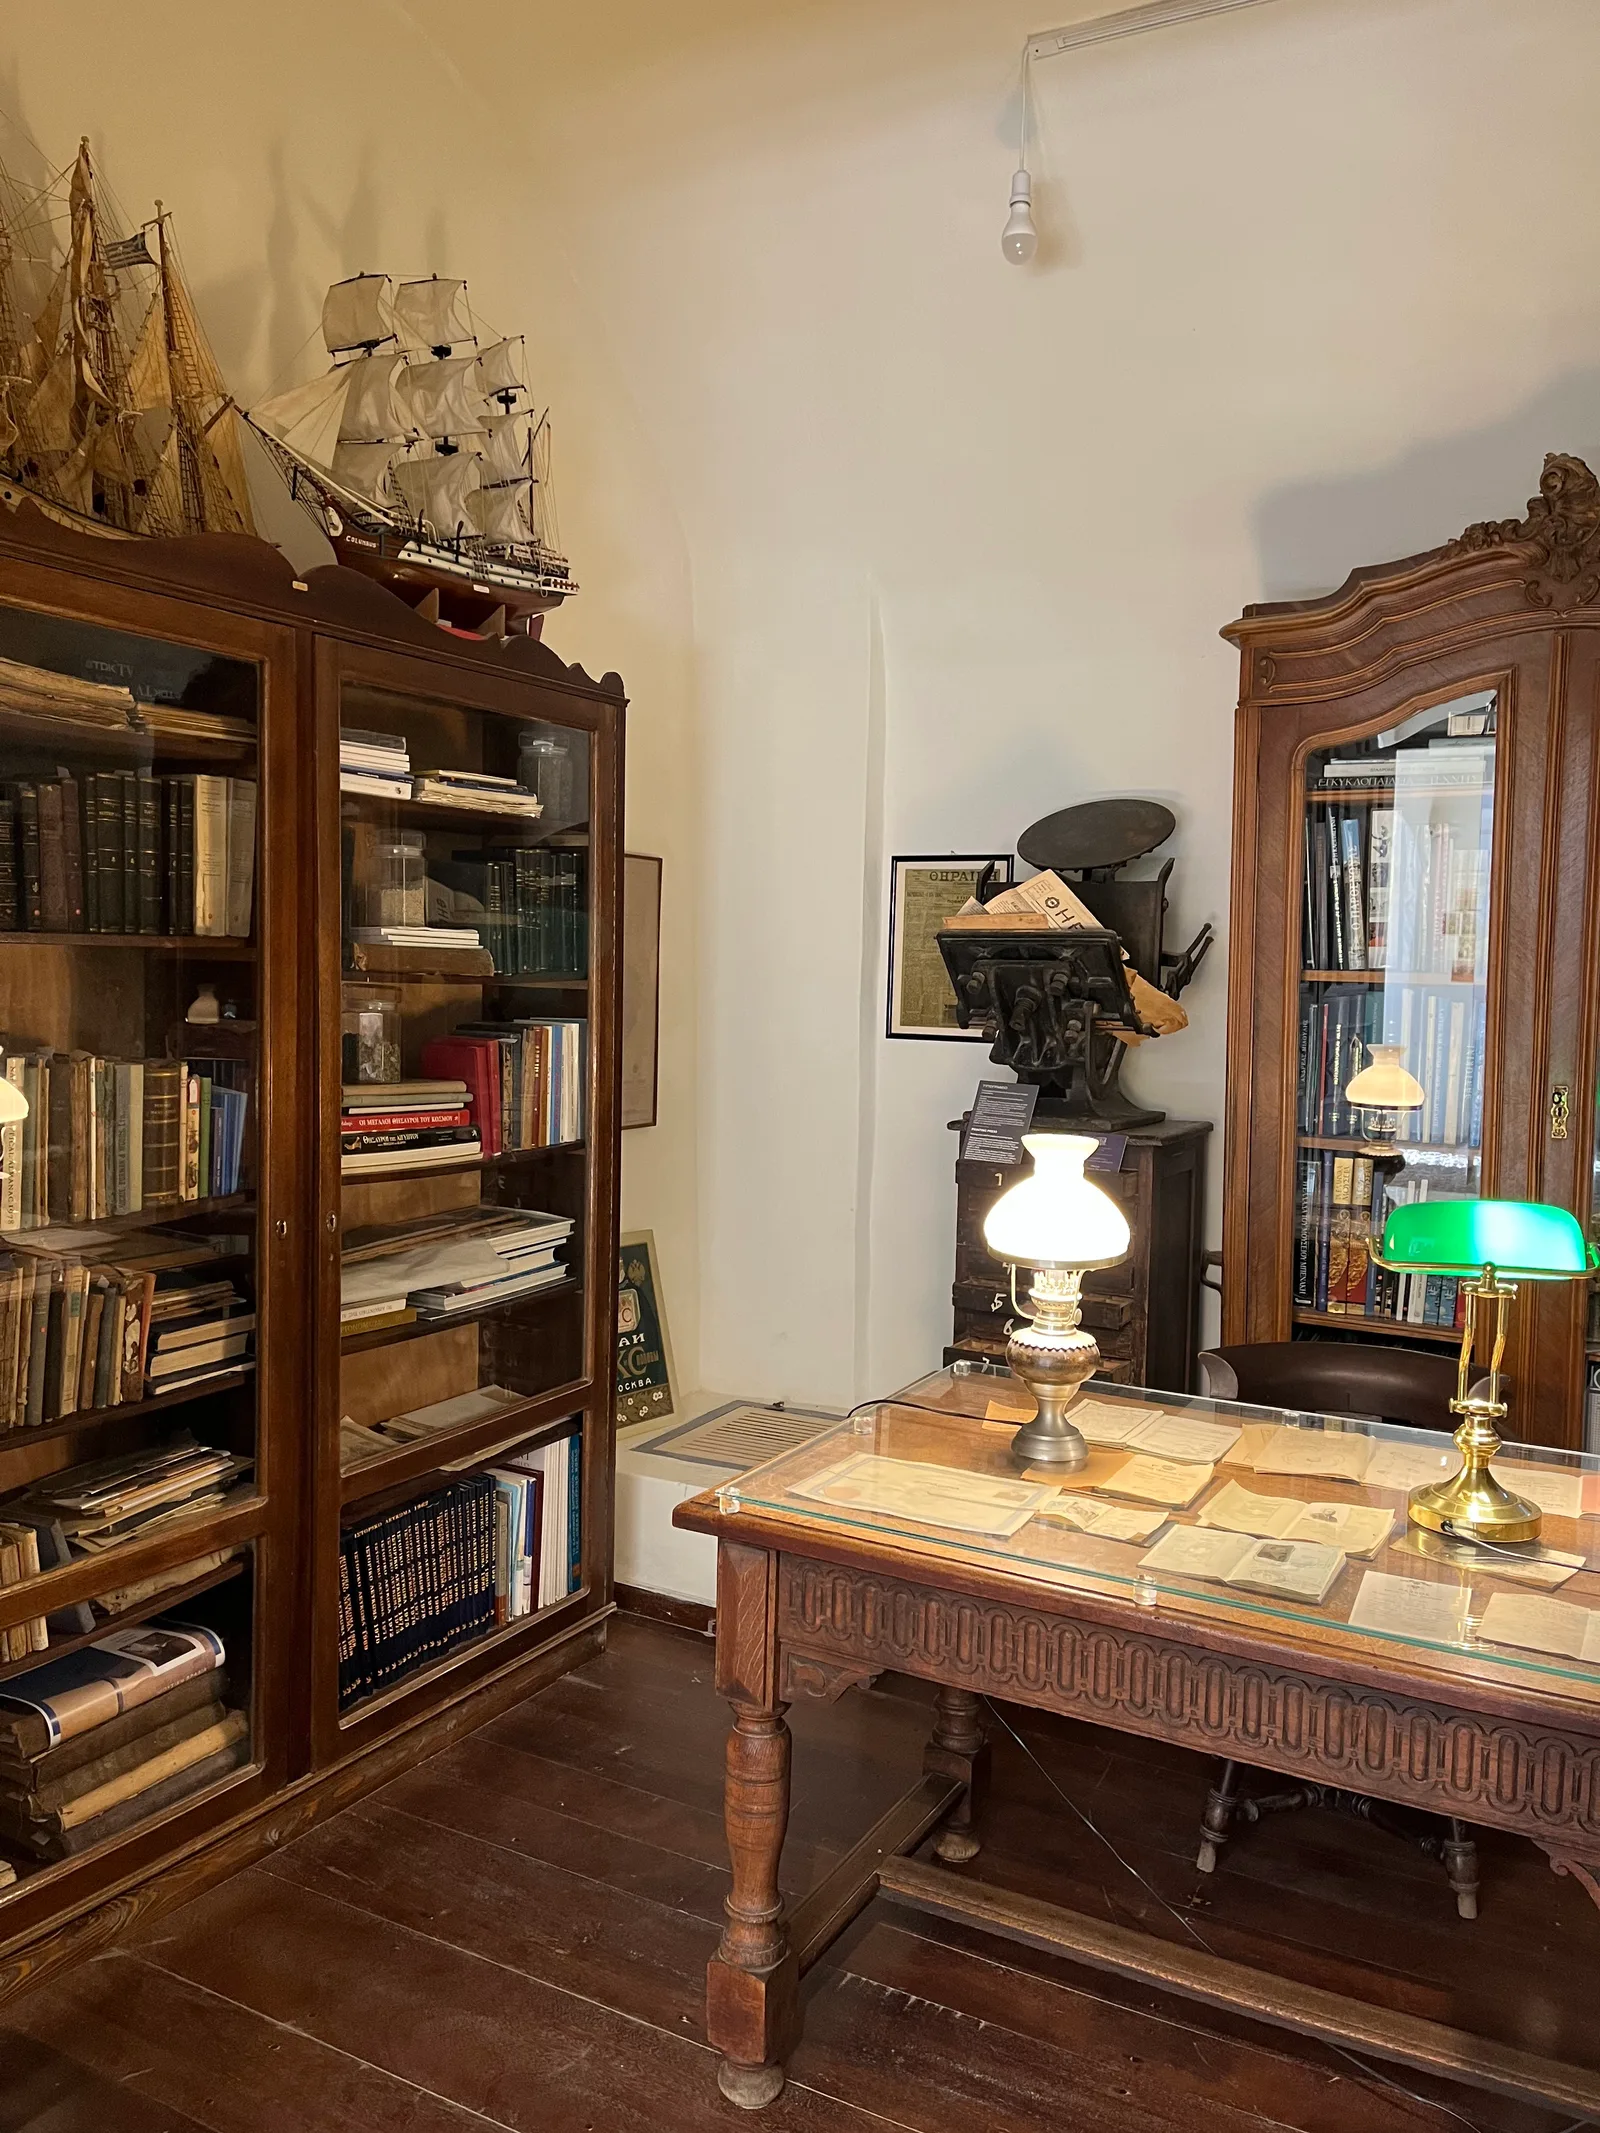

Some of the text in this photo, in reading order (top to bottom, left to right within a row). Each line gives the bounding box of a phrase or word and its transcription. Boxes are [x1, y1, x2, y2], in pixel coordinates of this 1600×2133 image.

[345, 534, 377, 549] COLUMBUS
[92, 660, 134, 677] TDK TV
[1298, 1262, 1307, 1295] ΜΠΕΝΑΚΗ
[990, 1293, 1007, 1312] 5
[1003, 1318, 1014, 1335] 6
[354, 1522, 383, 1539] ΙΣΤΟΡΙΚΟ
